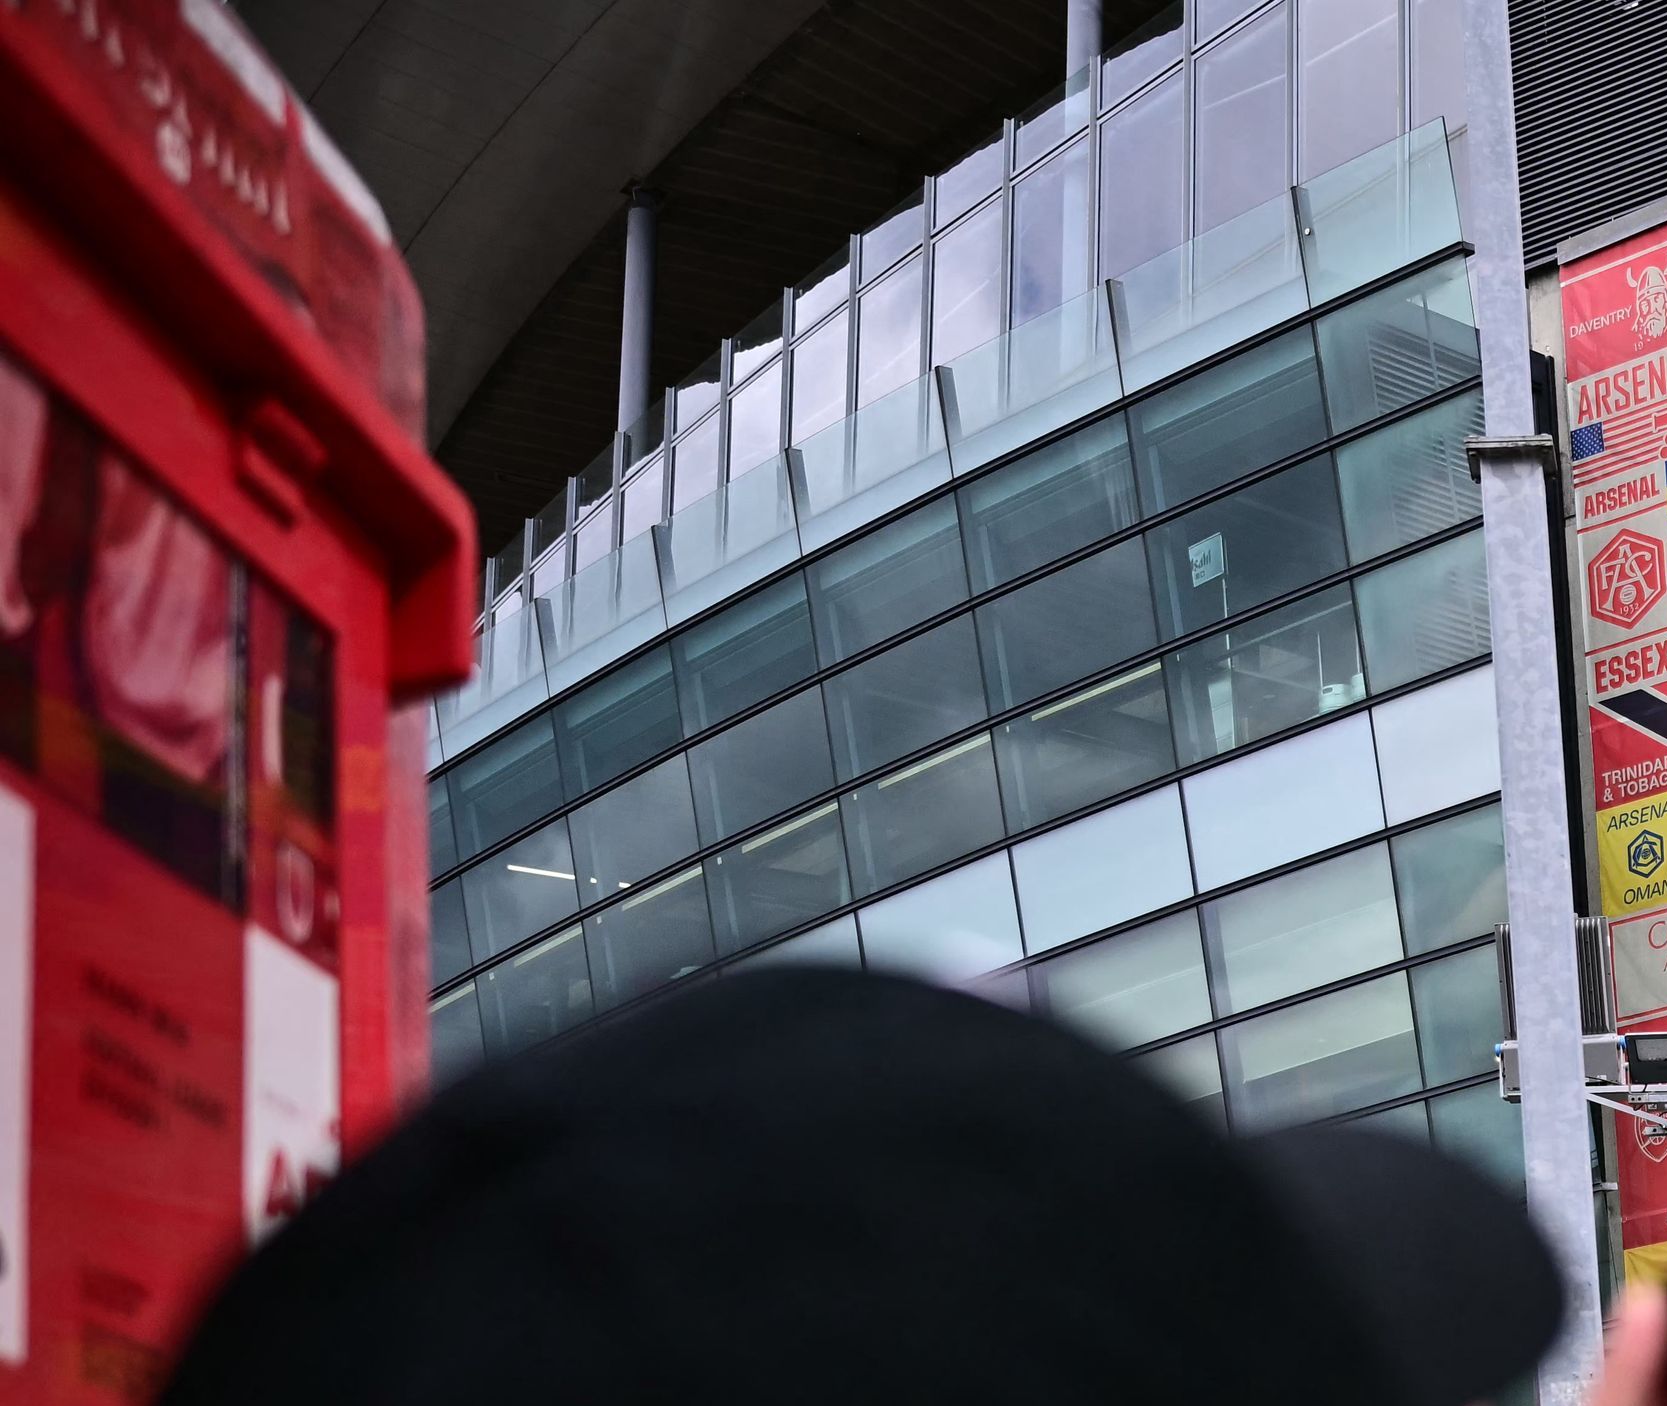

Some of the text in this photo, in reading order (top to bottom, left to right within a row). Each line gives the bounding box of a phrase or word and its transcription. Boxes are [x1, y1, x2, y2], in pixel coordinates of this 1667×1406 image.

[1569, 305, 1632, 337] DAVENTRY
[1584, 474, 1659, 520] ARSENAL
[1604, 785, 1615, 800] &
